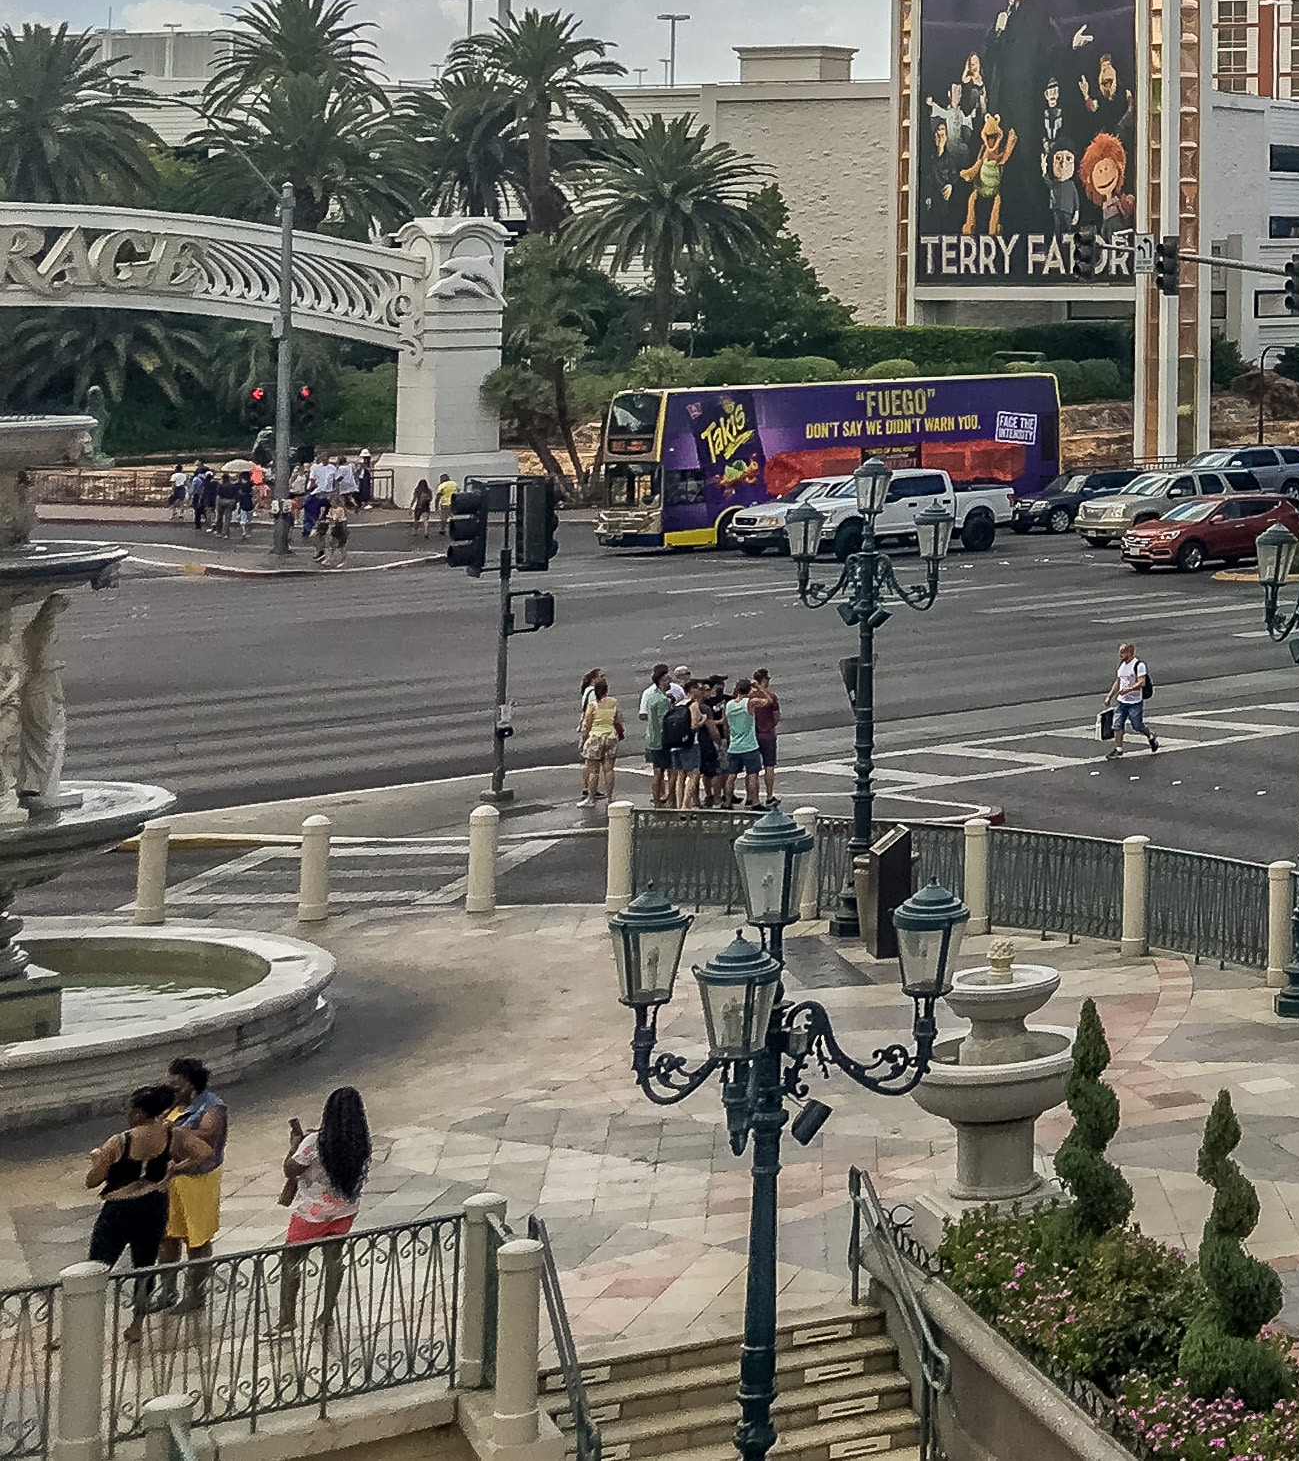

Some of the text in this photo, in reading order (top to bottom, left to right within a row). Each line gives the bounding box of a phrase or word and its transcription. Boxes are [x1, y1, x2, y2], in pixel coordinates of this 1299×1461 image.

[920, 233, 1020, 275] TERRY
[701, 403, 747, 464] Takis
[806, 421, 839, 439] DON'T
[843, 421, 863, 437] SAY
[866, 420, 882, 435] WE
[886, 417, 920, 435] DIDN'T
[925, 416, 954, 432] WARN
[1000, 415, 1034, 430] FACE THE
